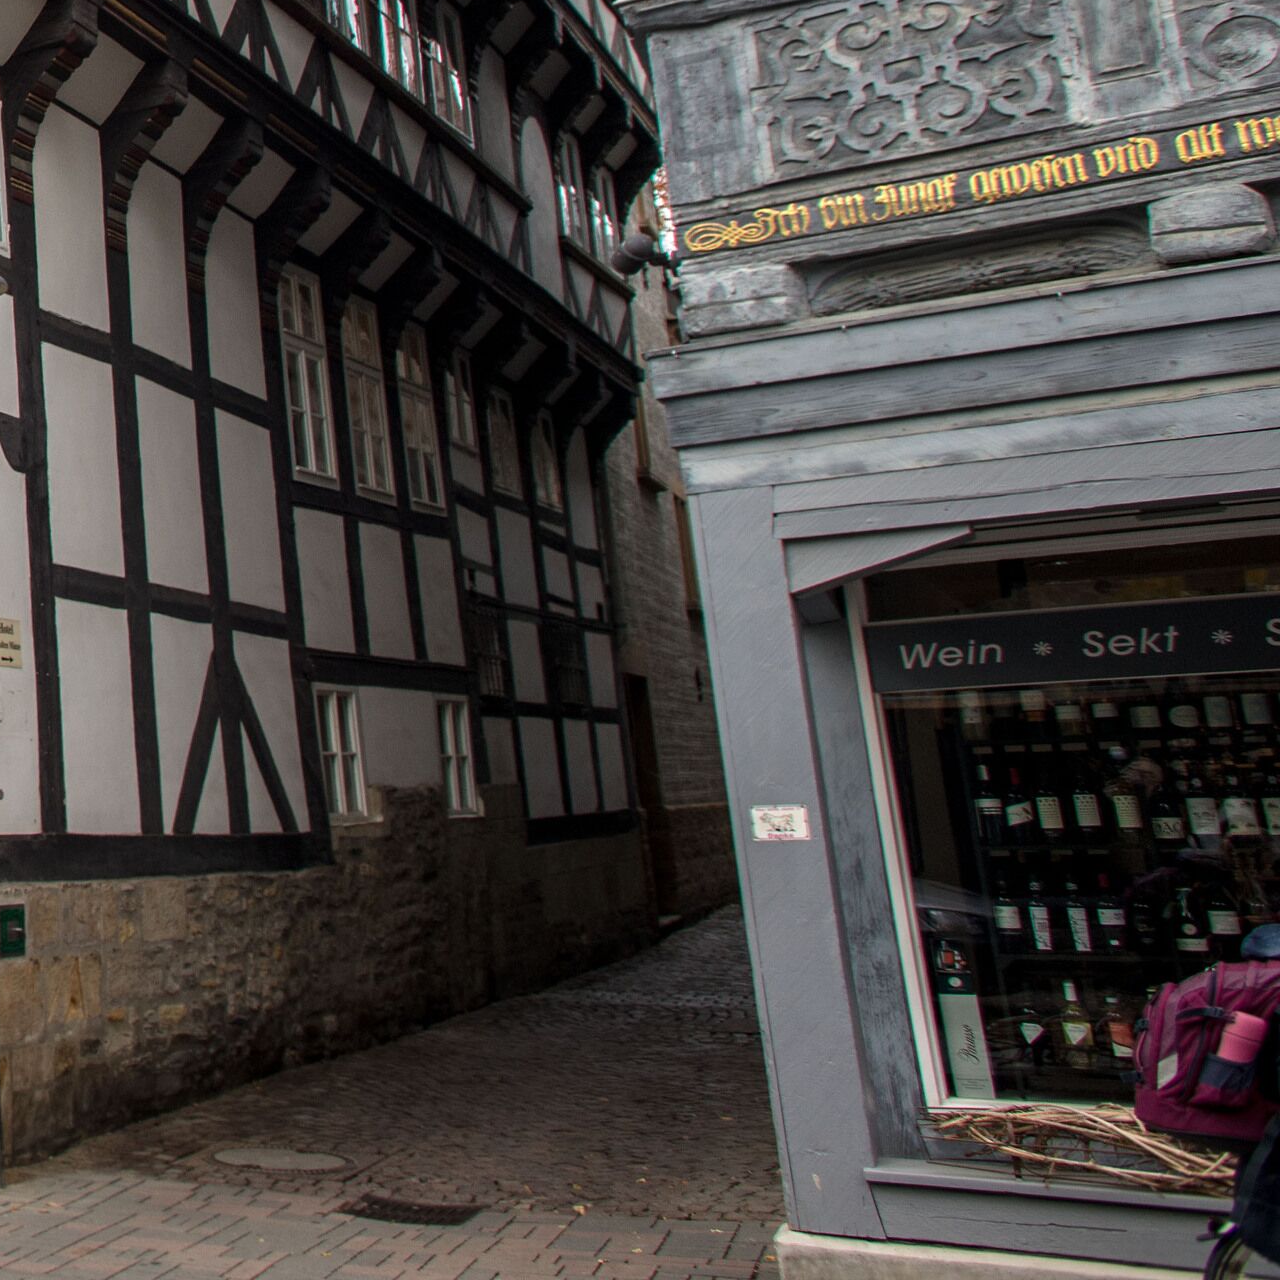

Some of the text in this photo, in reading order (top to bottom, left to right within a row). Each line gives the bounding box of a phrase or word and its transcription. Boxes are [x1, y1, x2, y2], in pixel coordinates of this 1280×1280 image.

[818, 193, 868, 230] bin
[969, 152, 1089, 204] gewesen
[899, 639, 1006, 670] Wein
[1082, 625, 1180, 659] Sekt
